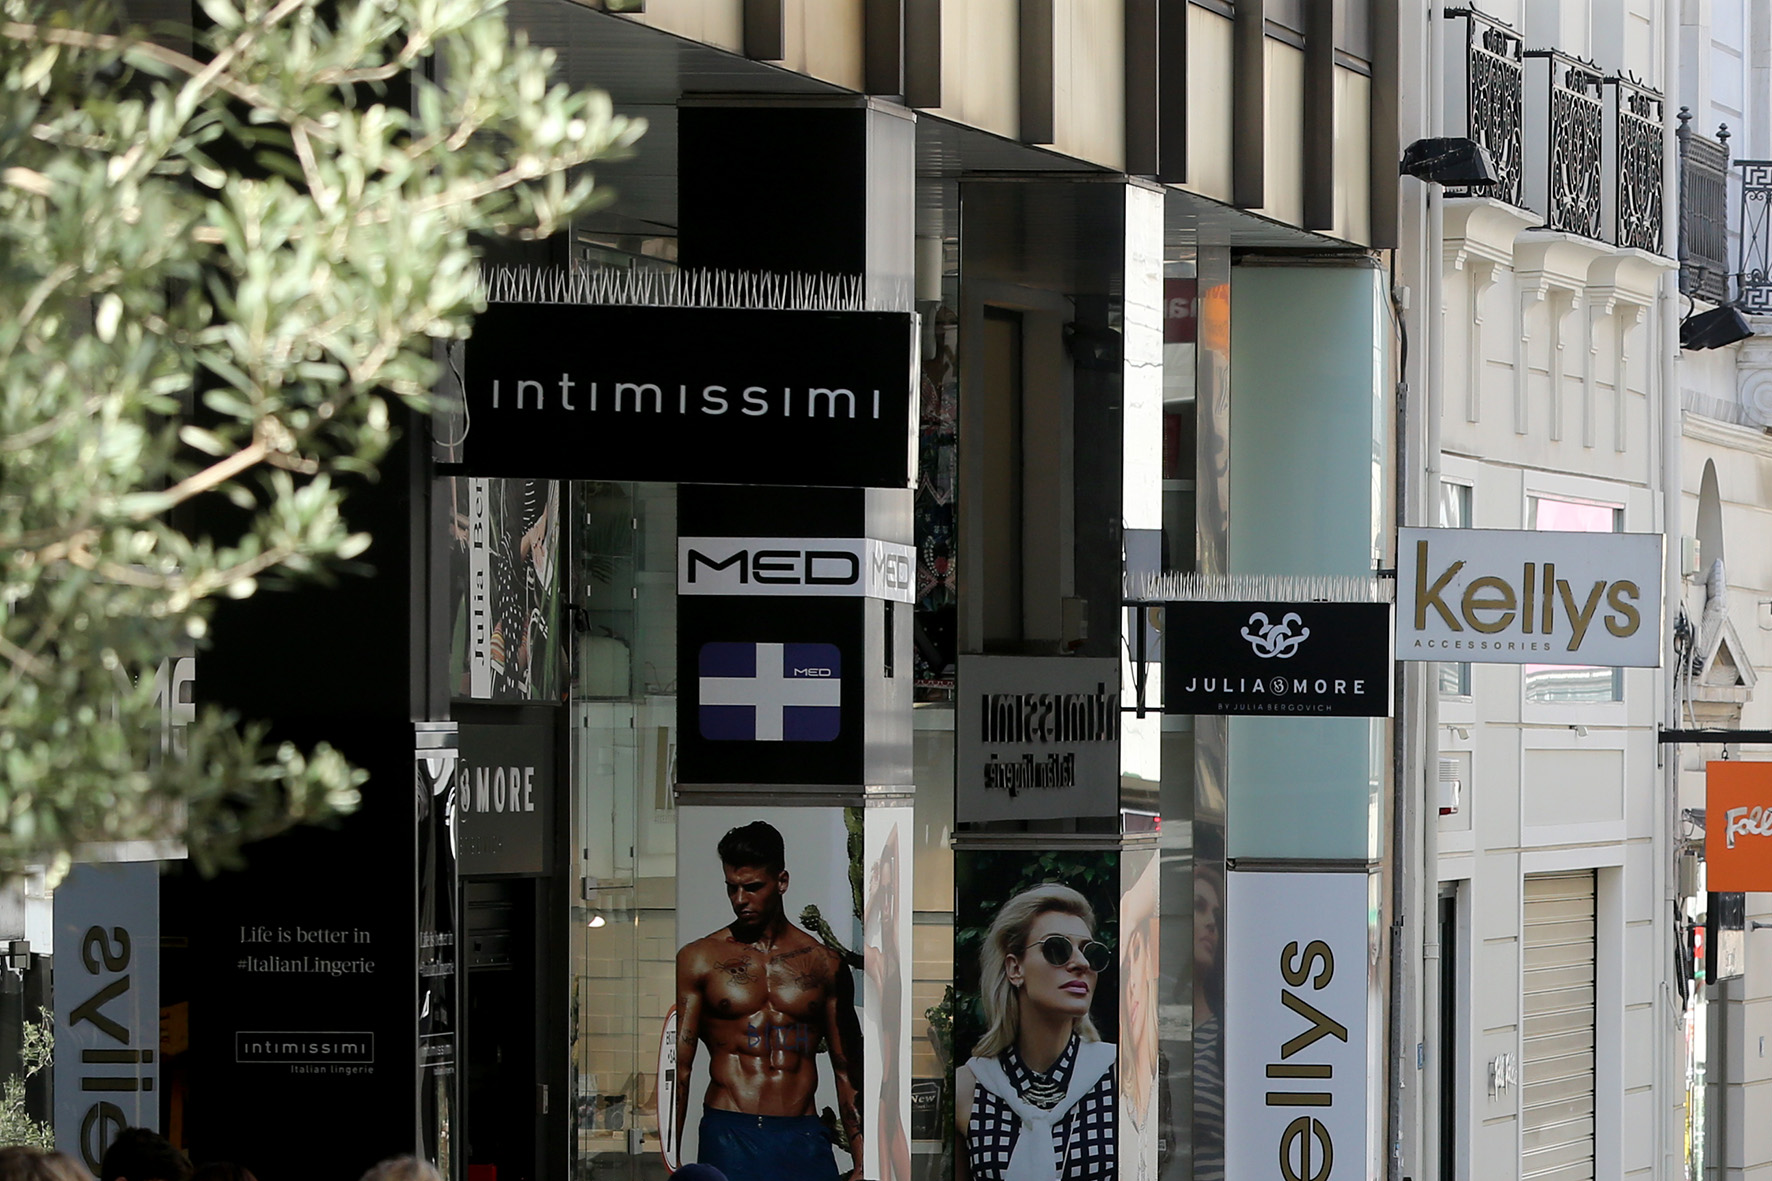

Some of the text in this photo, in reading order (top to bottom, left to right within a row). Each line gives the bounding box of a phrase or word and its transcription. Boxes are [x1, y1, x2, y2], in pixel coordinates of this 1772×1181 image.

[492, 373, 881, 419] intimissimi
[687, 549, 860, 586] MED
[1413, 639, 1552, 652] ACCESSORIES
[794, 667, 831, 677] MED
[1185, 678, 1265, 694] JULIA
[1293, 679, 1366, 695] MORE
[1217, 703, 1333, 712] BY JULIA BERGOVICH
[476, 767, 535, 813] MORE
[240, 926, 372, 944] Life is better in
[237, 956, 376, 977] #ItalianLingerie
[244, 1041, 366, 1054] intimissimi
[291, 1064, 375, 1076] Italian lingerie
